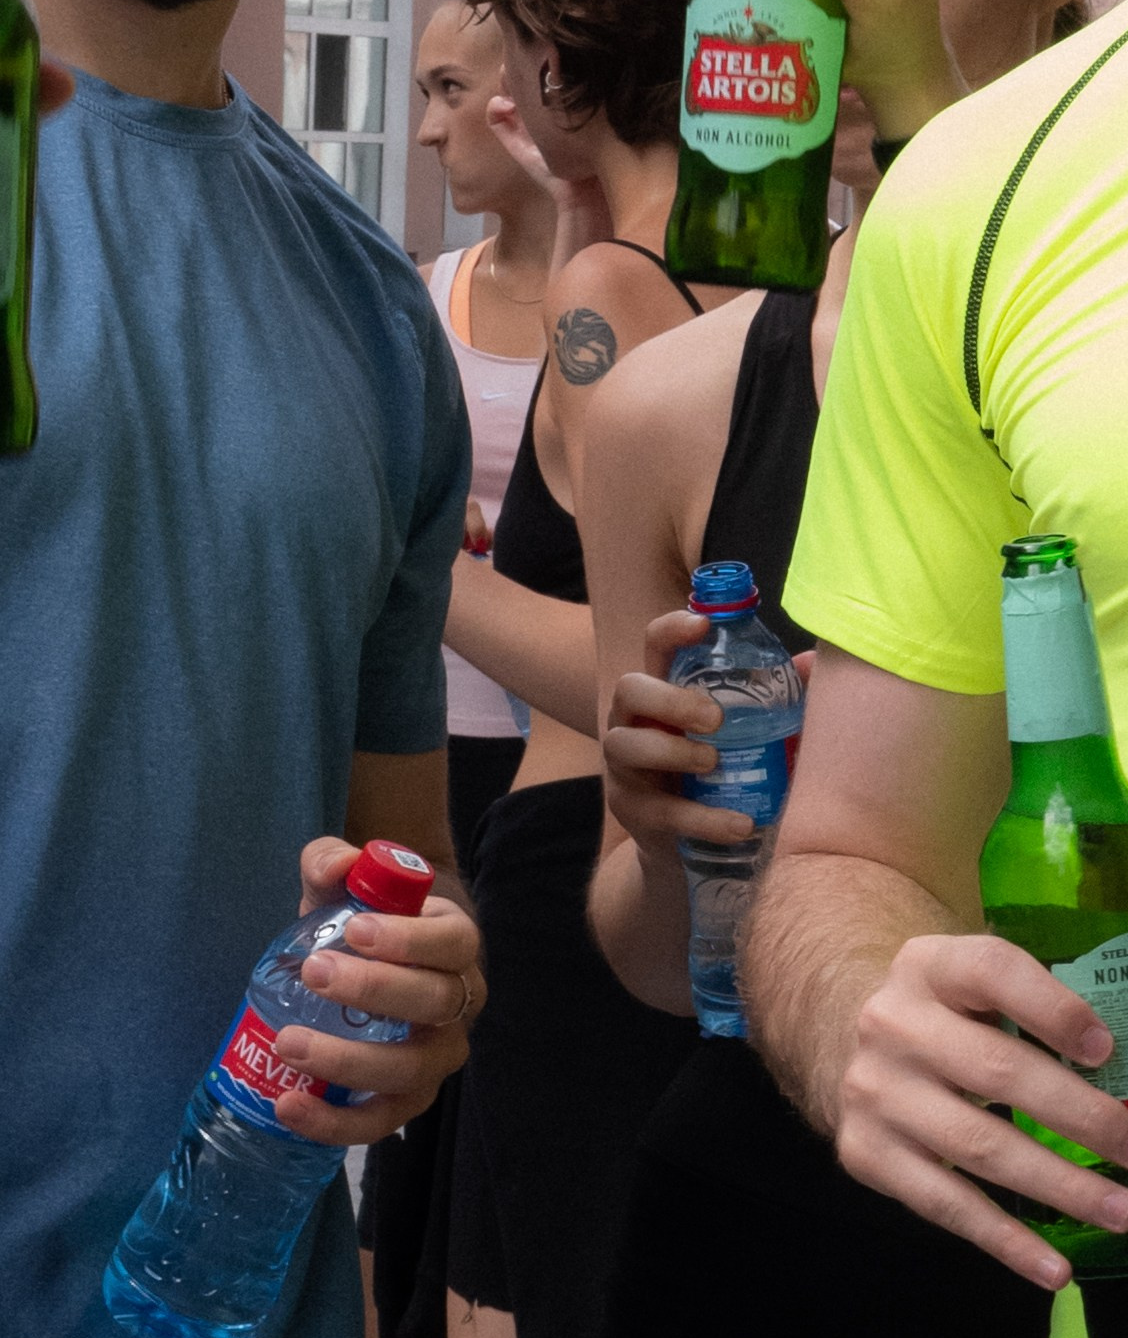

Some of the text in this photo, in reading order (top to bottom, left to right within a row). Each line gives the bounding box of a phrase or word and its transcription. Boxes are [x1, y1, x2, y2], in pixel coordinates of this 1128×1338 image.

[701, 49, 797, 79] STELLA
[698, 74, 796, 105] ARTOIS
[696, 127, 790, 148] NON ALCOHOL
[233, 1032, 315, 1094] MEVER
